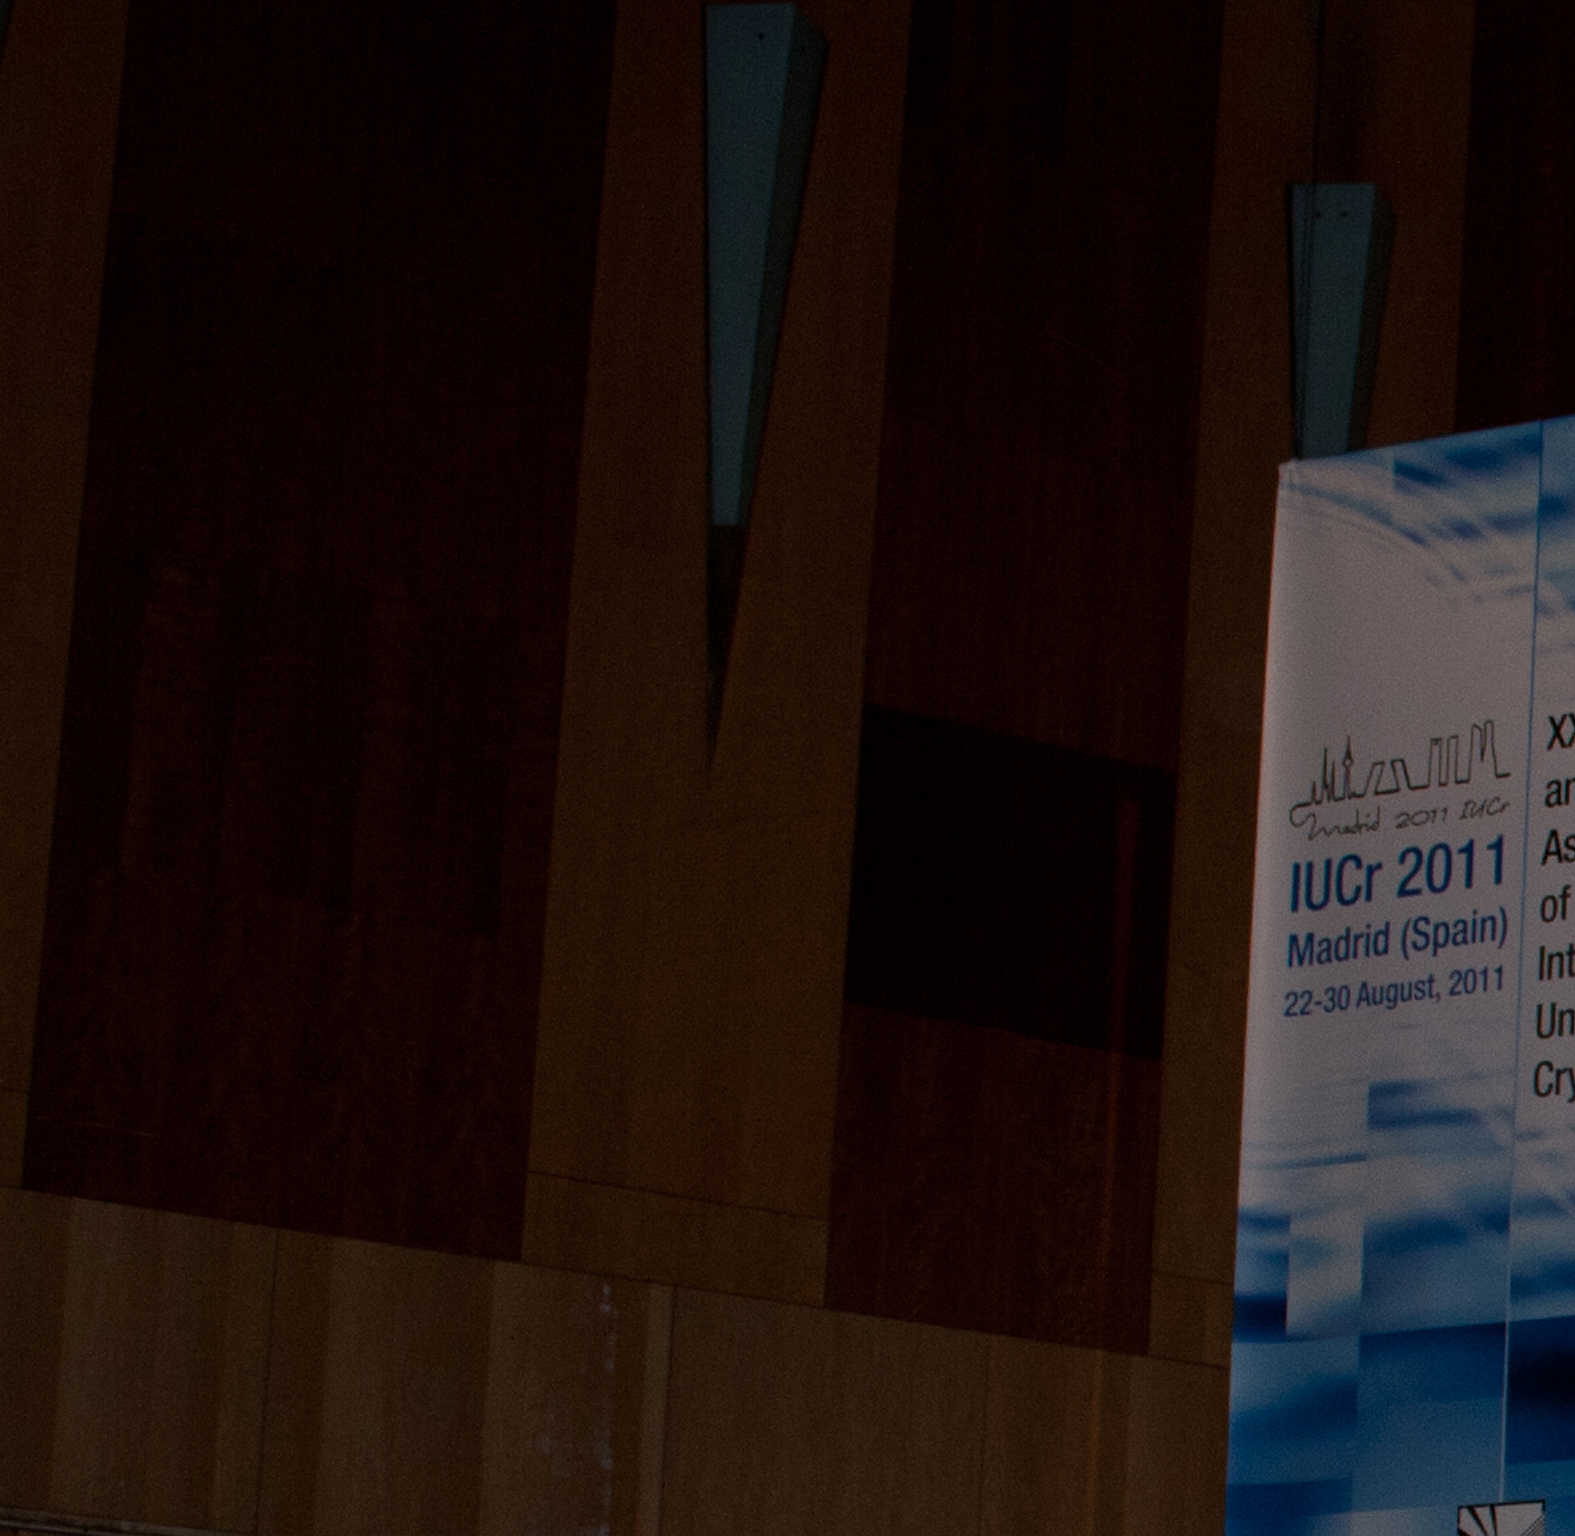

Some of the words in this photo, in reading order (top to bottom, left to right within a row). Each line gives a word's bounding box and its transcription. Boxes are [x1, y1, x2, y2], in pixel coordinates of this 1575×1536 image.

[1289, 856, 1382, 913] IUCr
[1397, 834, 1505, 899] 2011
[1540, 889, 1570, 923] of
[1287, 922, 1389, 968] Madrid
[1401, 906, 1508, 961] (Spain)
[1284, 983, 1351, 1017] 22-30
[1356, 973, 1441, 1009] August,
[1449, 966, 1504, 995] 2011
